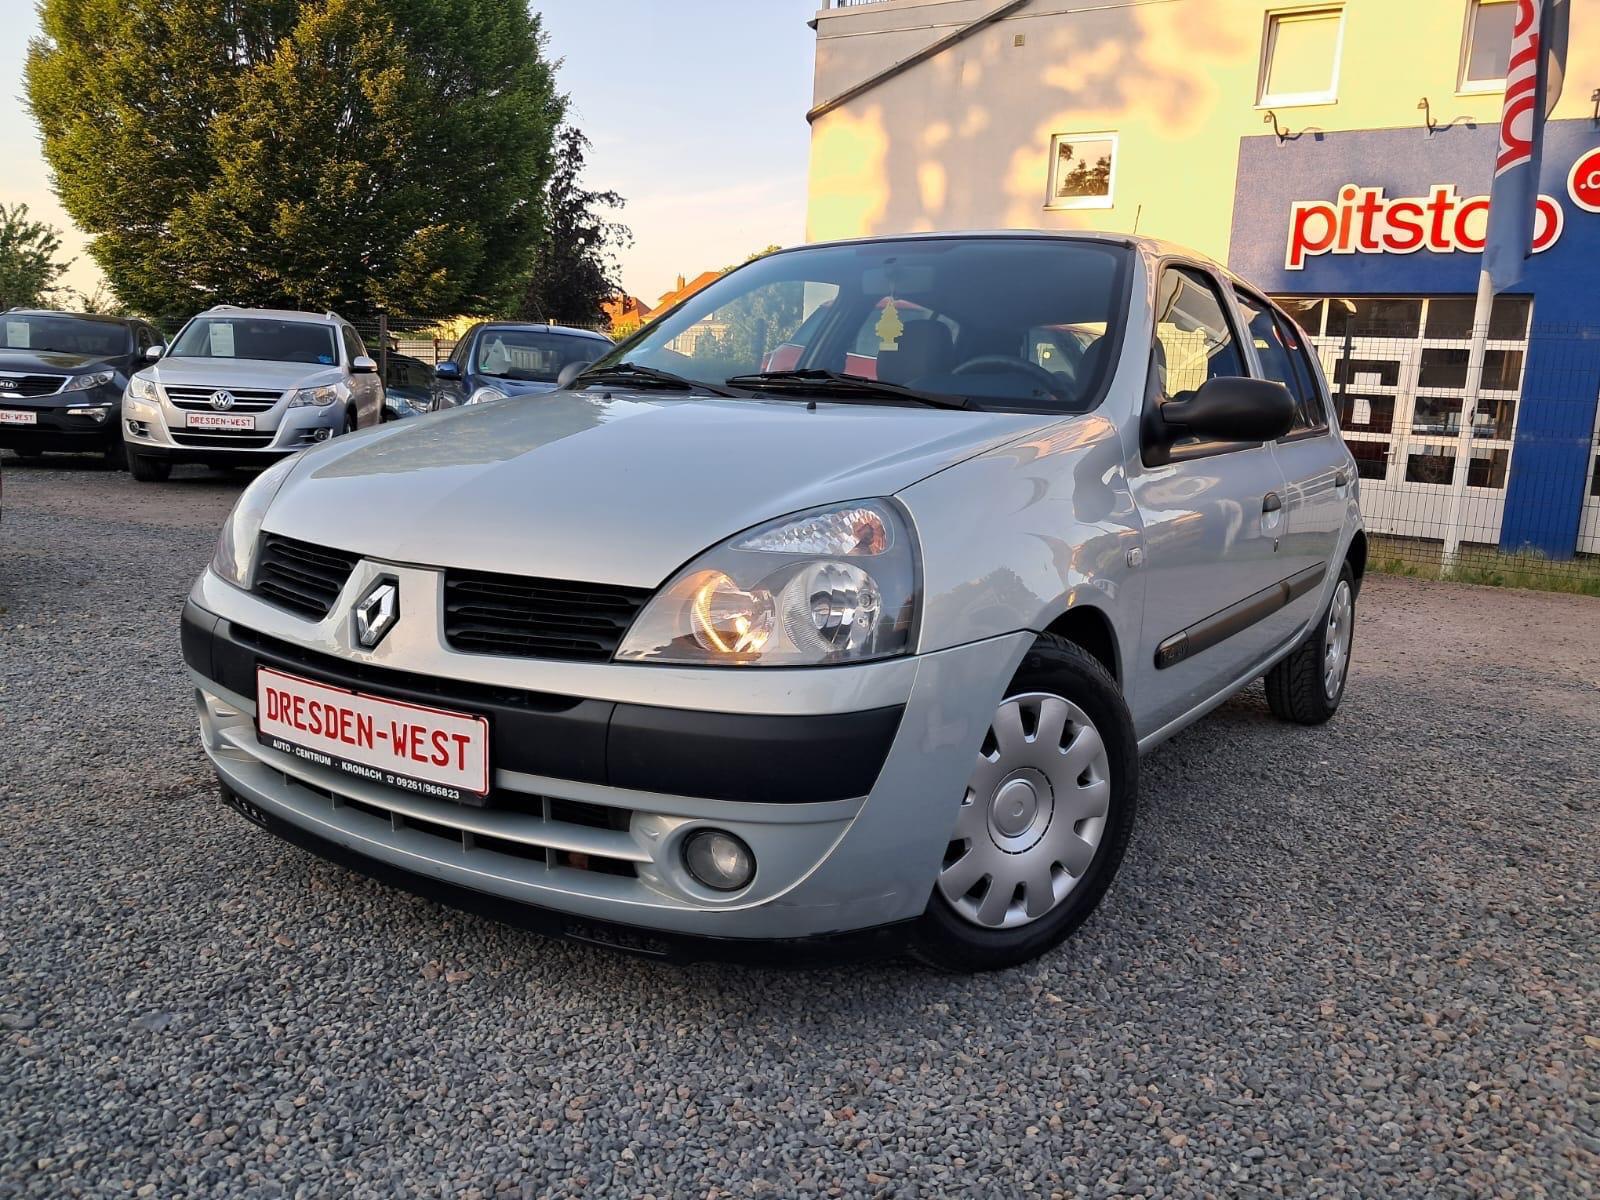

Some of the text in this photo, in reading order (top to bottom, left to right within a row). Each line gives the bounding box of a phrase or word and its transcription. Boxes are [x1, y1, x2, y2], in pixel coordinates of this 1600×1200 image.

[189, 416, 251, 427] DRESDEN-WEST
[265, 687, 471, 771] DRESDEN-WEST
[272, 739, 291, 753] AUTO
[295, 747, 331, 767] CENTRUM
[341, 761, 382, 781] KRONACH
